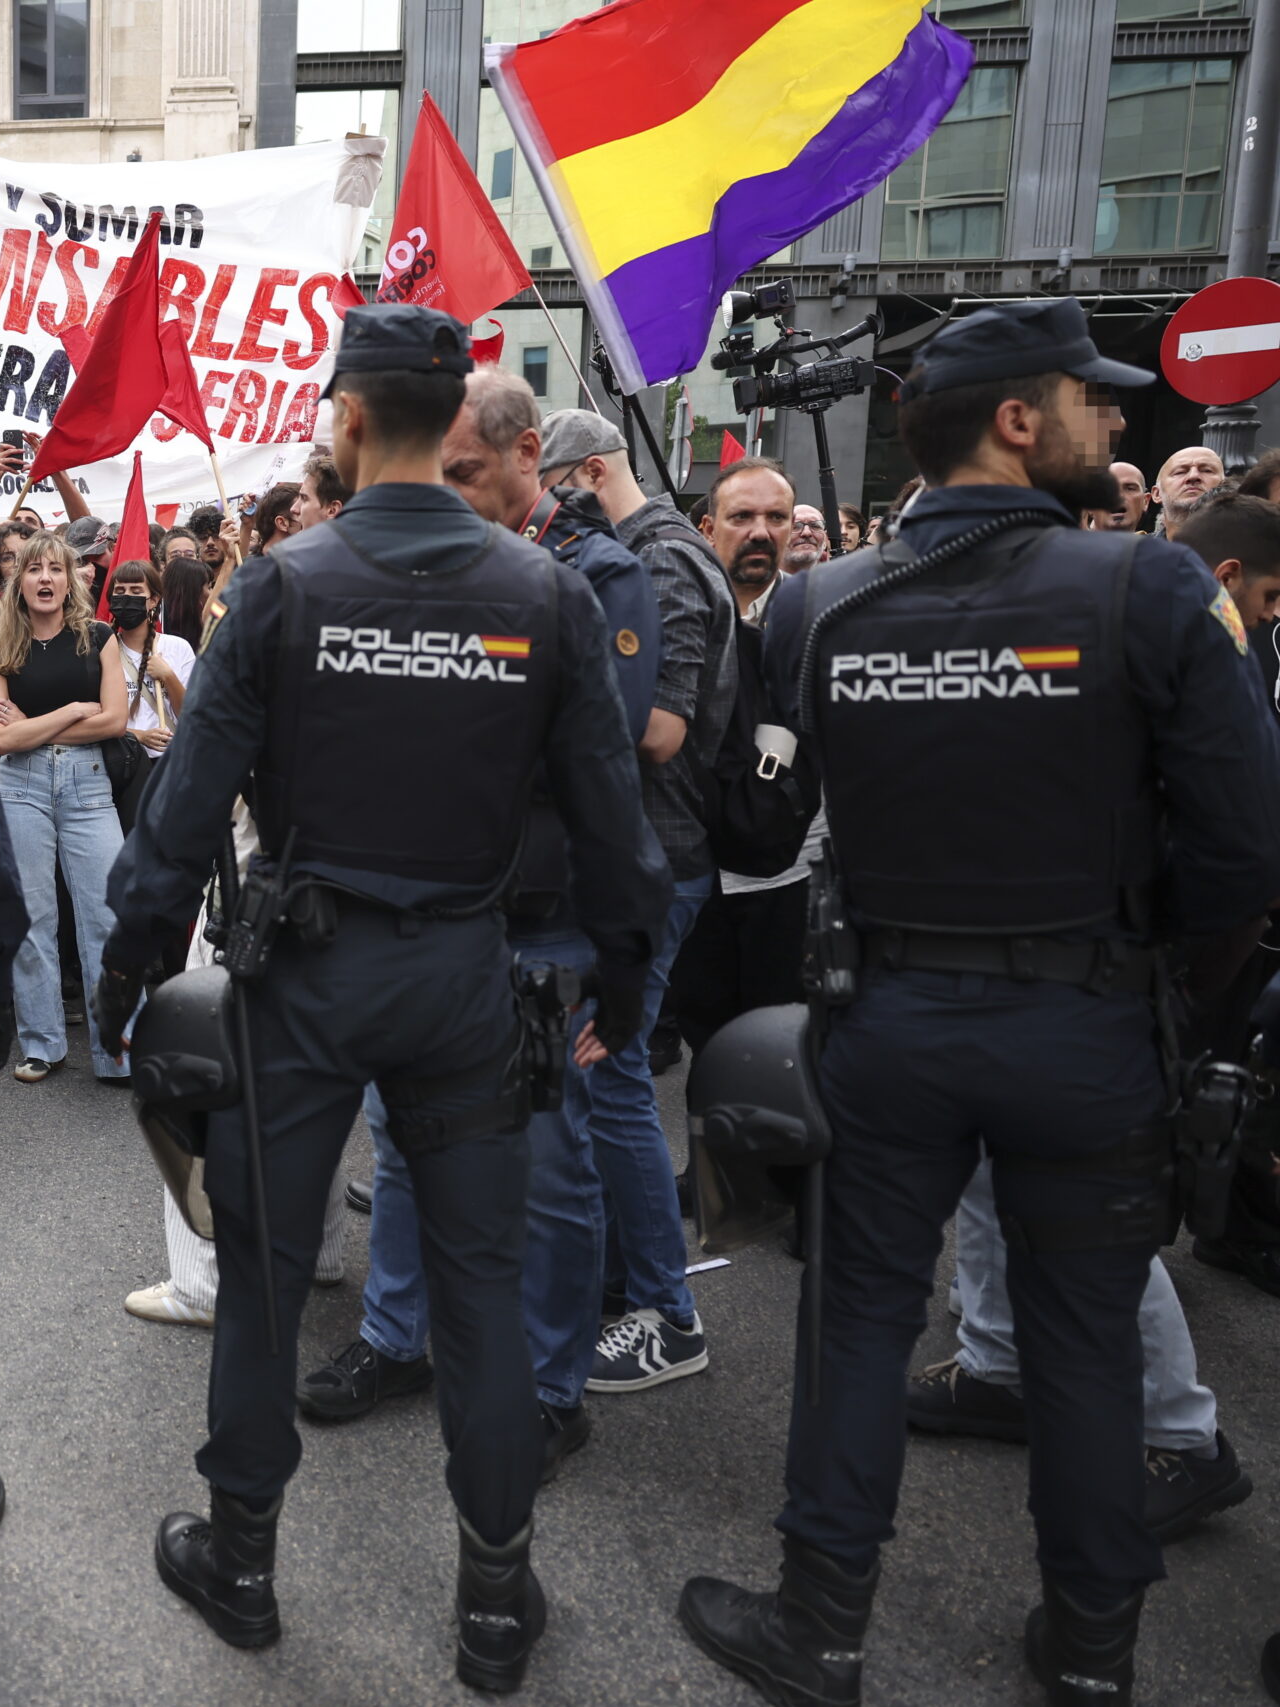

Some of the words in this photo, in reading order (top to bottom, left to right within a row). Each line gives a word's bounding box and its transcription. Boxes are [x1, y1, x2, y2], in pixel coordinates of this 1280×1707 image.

[5, 182, 24, 212] Y
[35, 191, 204, 249] SUMAR
[318, 626, 487, 657] POLICIA
[316, 650, 527, 682] NACIONAL
[830, 647, 1024, 678] POLICIA
[830, 672, 1080, 702] NACIONAL
